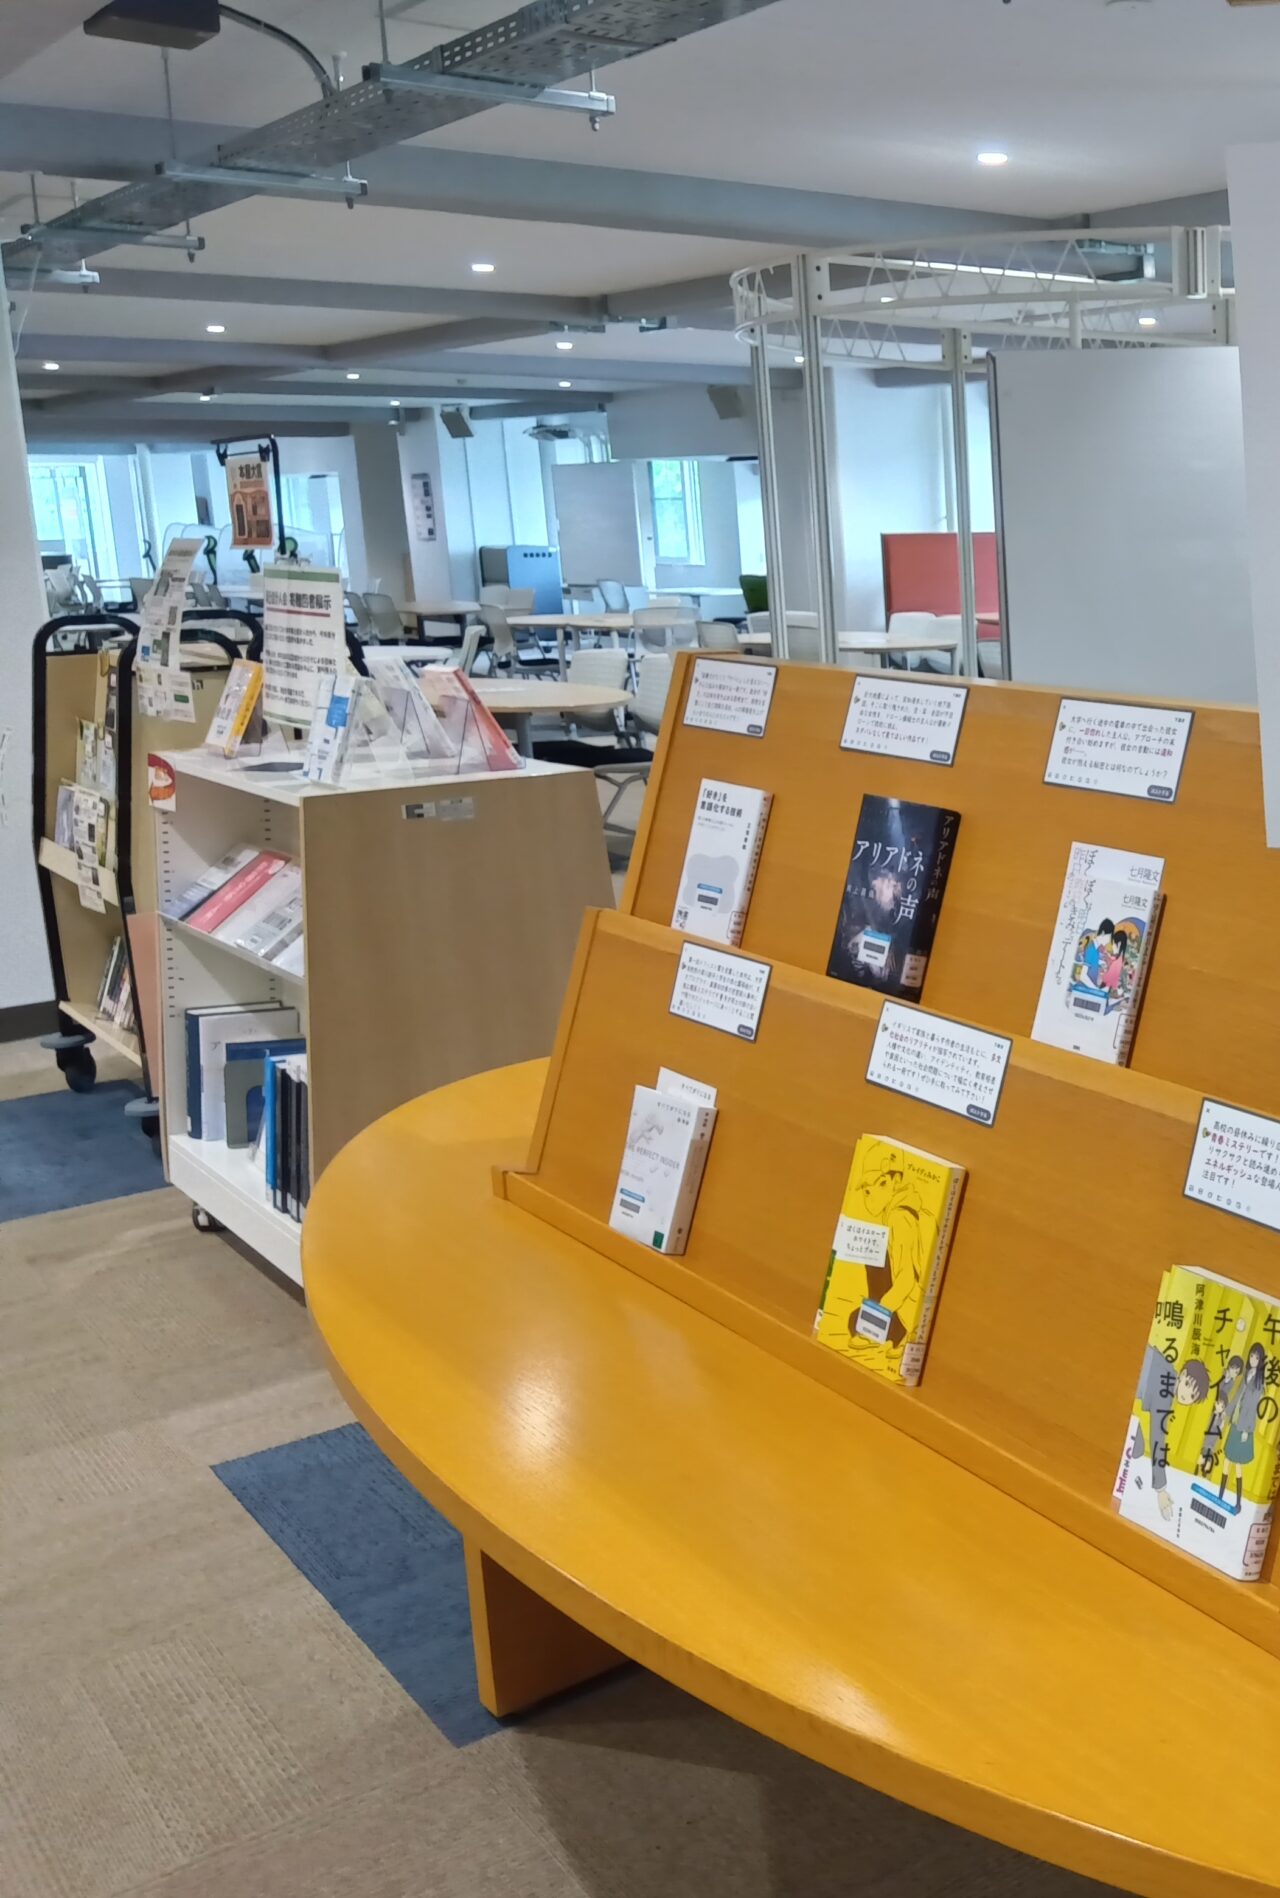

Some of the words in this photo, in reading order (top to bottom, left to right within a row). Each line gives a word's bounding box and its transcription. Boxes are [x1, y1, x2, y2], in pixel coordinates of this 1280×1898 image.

[1152, 1300, 1185, 1468] 鳴るまでは
[1201, 1307, 1234, 1477] チャイムが
